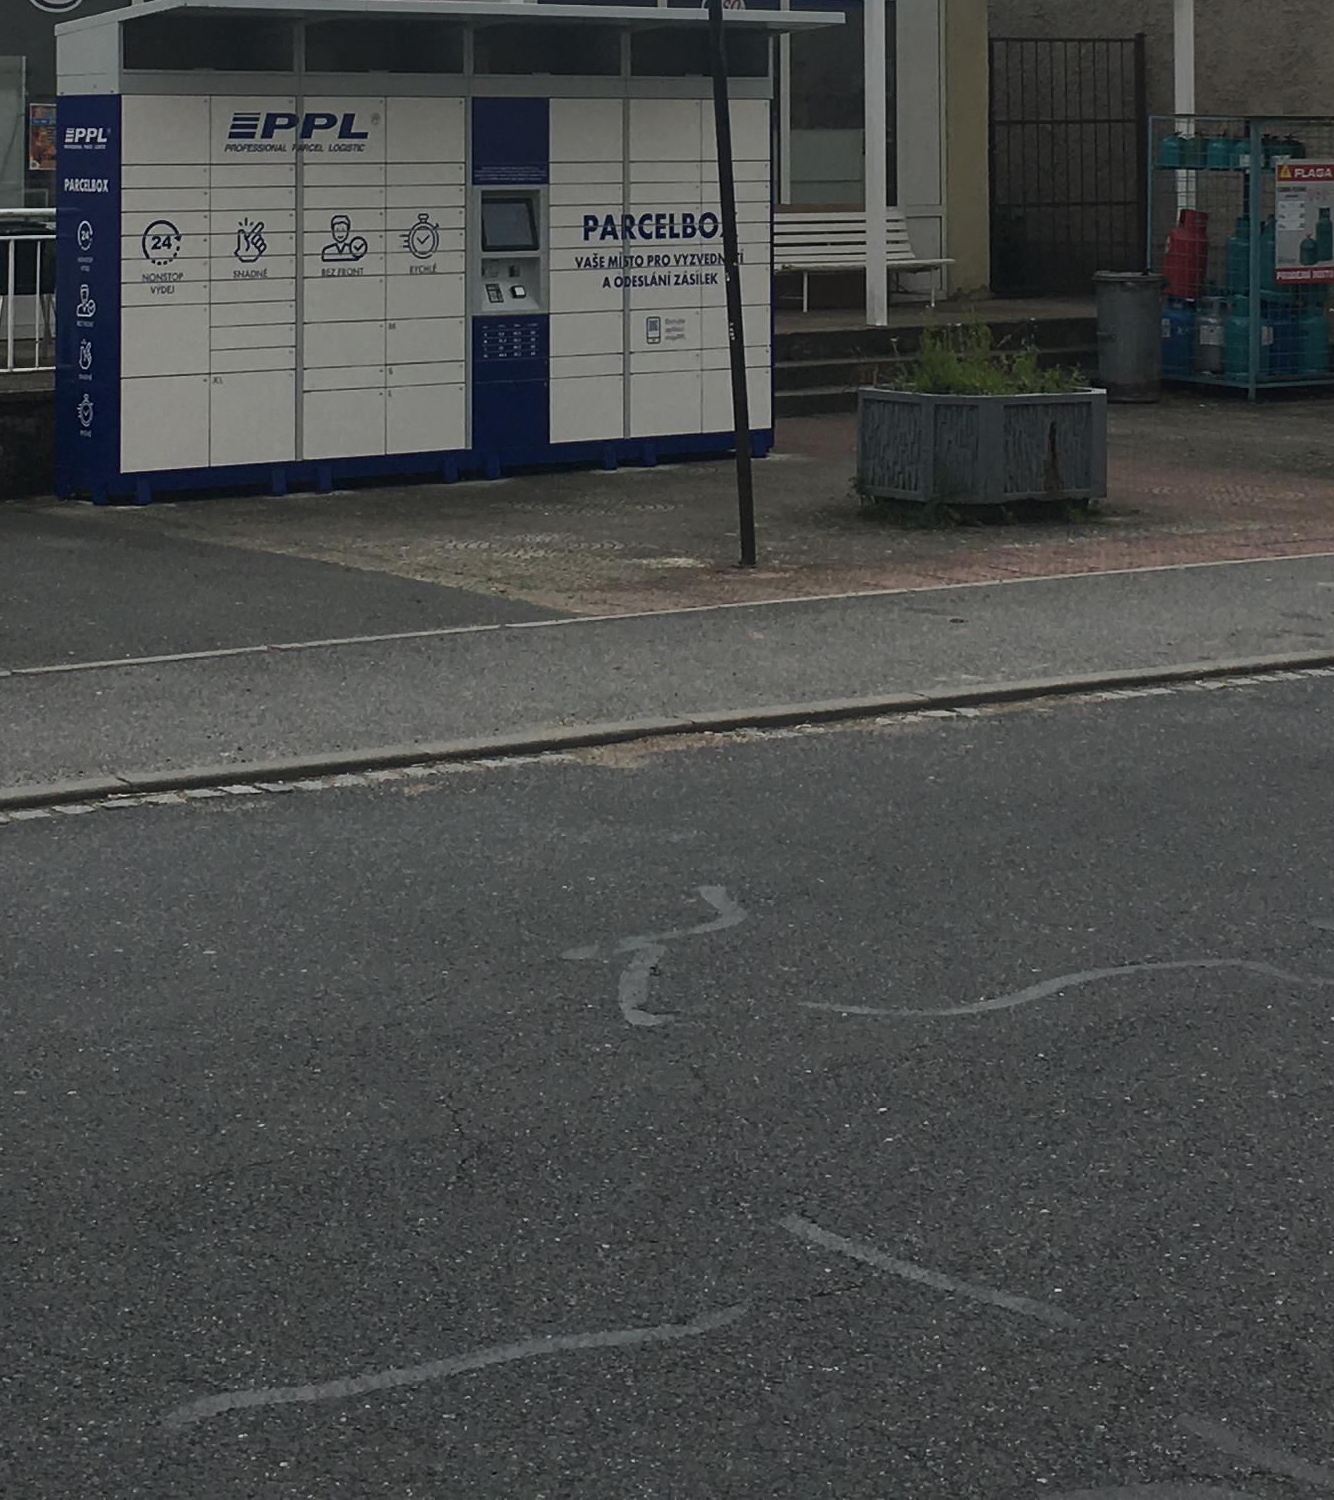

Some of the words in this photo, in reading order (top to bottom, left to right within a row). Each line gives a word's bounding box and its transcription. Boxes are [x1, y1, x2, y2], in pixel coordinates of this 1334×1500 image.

[224, 143, 288, 153] PROFESSIONAL
[328, 143, 366, 152] LOGISTIC
[64, 178, 109, 193] PARCELBOX
[80, 230, 90, 241] 24
[151, 235, 173, 250] 24
[575, 253, 605, 268] VAŠE
[607, 251, 644, 268] MÍSTO
[647, 254, 671, 268] PRO
[142, 272, 184, 283] NONSTOP
[602, 276, 611, 288] A
[613, 270, 671, 288] ODESLÁNÍ
